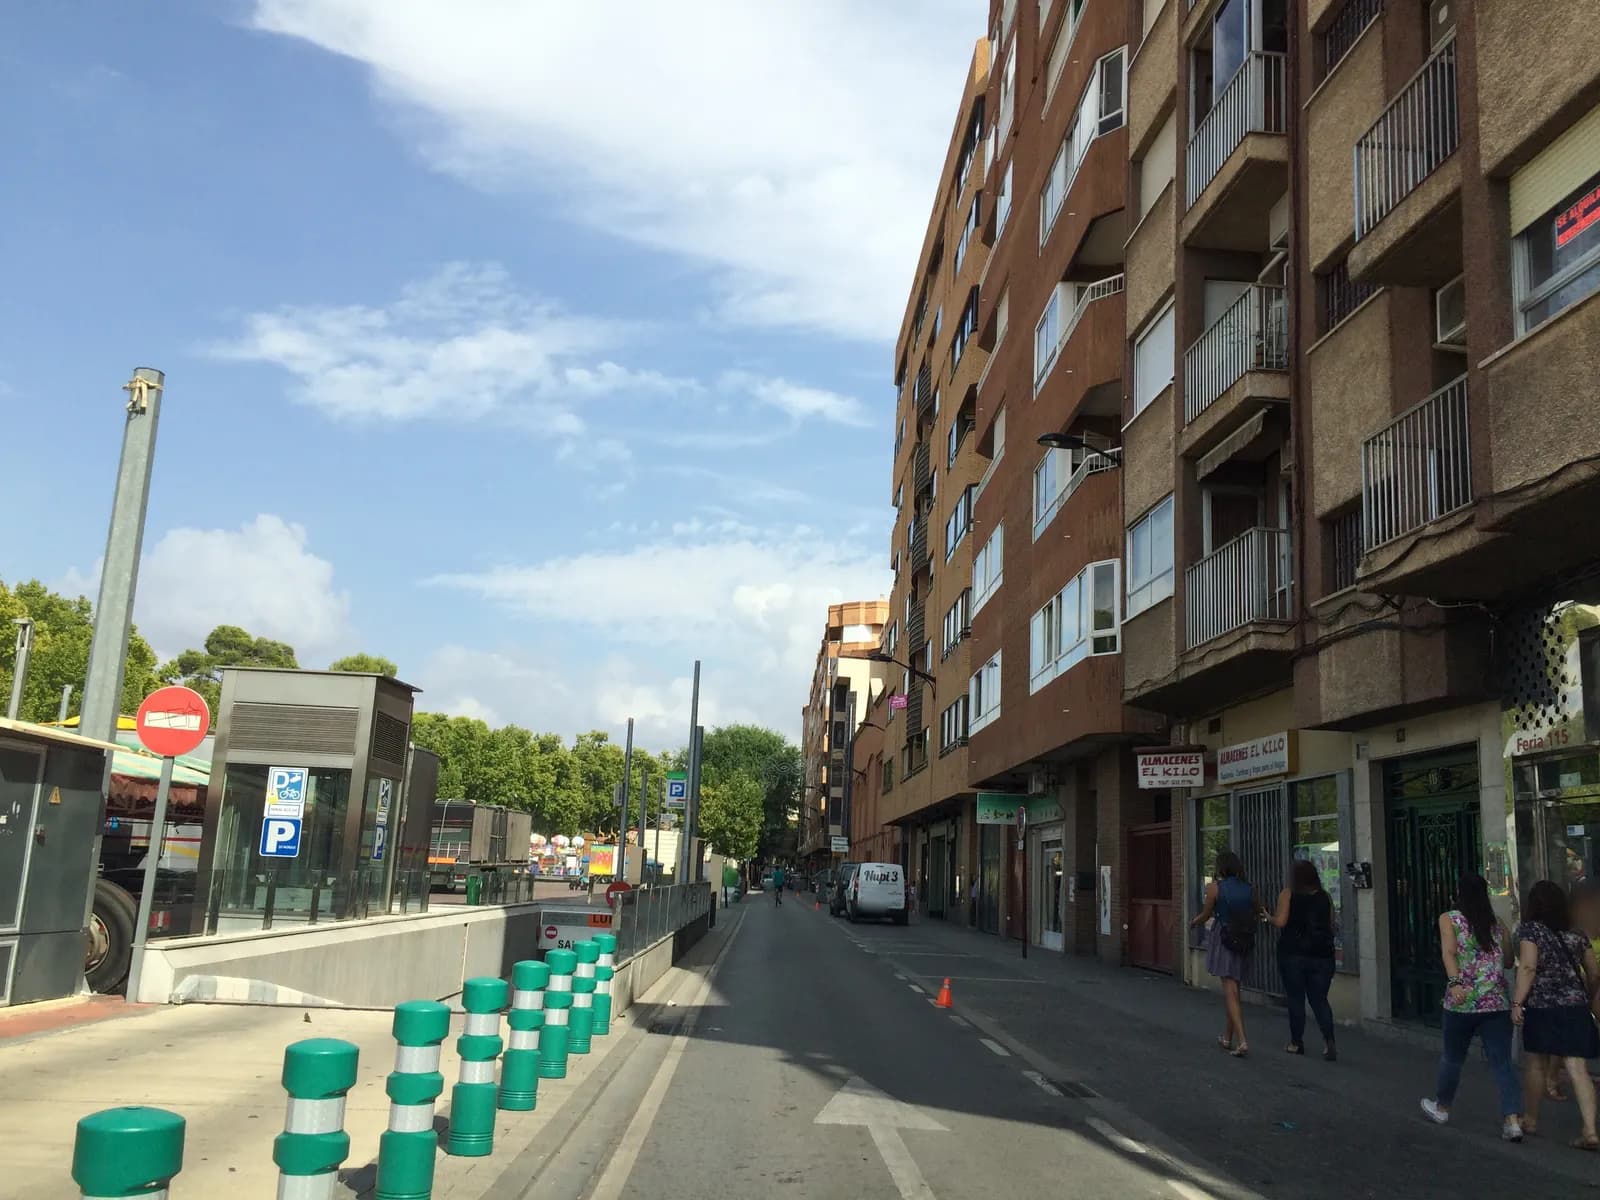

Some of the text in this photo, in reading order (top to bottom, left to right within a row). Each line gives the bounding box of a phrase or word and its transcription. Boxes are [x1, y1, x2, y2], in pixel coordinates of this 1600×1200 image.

[1516, 729, 1569, 752] Feria 115
[1141, 755, 1200, 766] ALMACENES
[1220, 738, 1284, 765] ALMACENES EL KILO
[1142, 767, 1199, 776] EL KILO
[672, 784, 683, 795] P
[265, 821, 296, 853] P
[374, 827, 384, 857] P
[864, 870, 899, 885] Nupi 3
